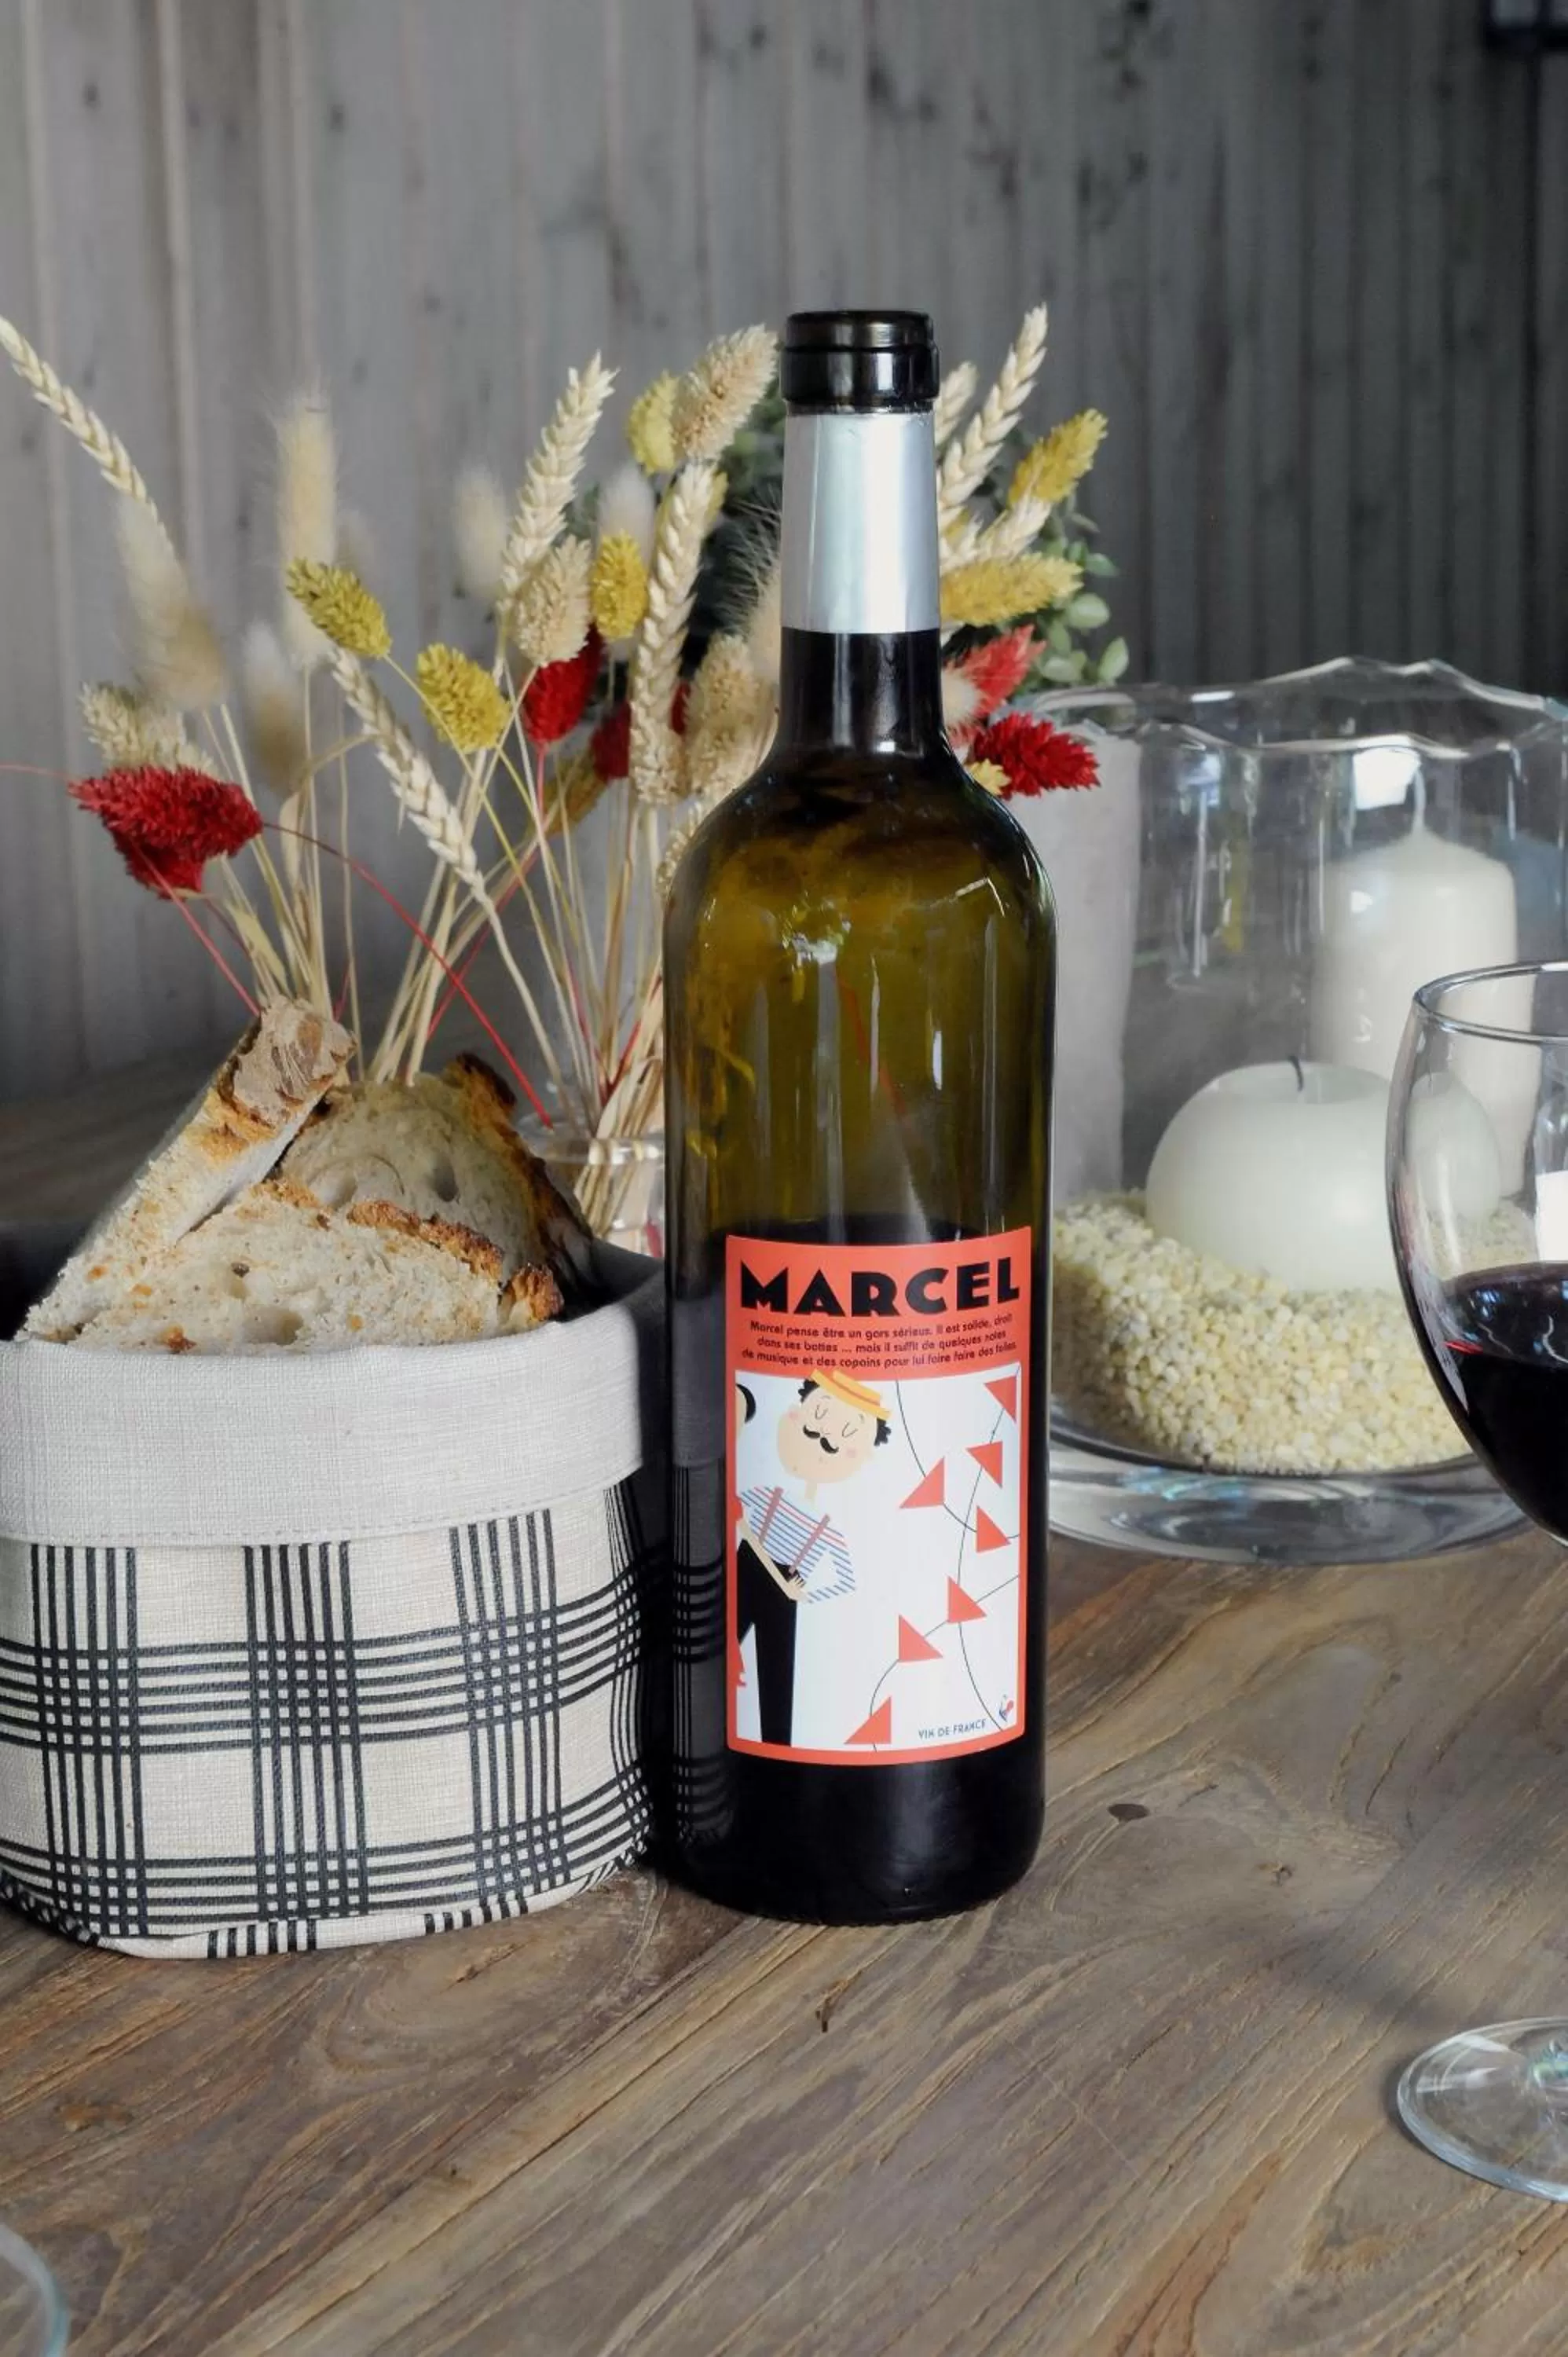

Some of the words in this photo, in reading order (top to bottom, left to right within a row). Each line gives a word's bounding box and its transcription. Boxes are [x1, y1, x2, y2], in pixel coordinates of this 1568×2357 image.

[741, 1257, 1020, 1317] MARCEL
[750, 1320, 783, 1334] Marcel
[786, 1328, 819, 1337] pense
[823, 1327, 844, 1338] être
[865, 1329, 889, 1340] gars
[946, 1324, 960, 1334] est
[757, 1336, 781, 1348] dans
[784, 1341, 800, 1351] ses
[855, 1343, 881, 1353] mais
[894, 1340, 919, 1352] suffit
[922, 1340, 936, 1350] de
[939, 1335, 981, 1350] quelques
[742, 1349, 754, 1358] de
[757, 1351, 799, 1366] musique
[803, 1356, 813, 1365] et
[816, 1355, 836, 1366] des
[839, 1357, 881, 1369] copains
[884, 1358, 910, 1369] pour
[912, 1355, 925, 1366] lui
[927, 1353, 951, 1365] faire
[954, 1350, 975, 1362] faire
[978, 1346, 994, 1357] des
[918, 1728, 934, 1739] VIN
[937, 1726, 950, 1737] DE
[953, 1718, 986, 1734] FRANCE
